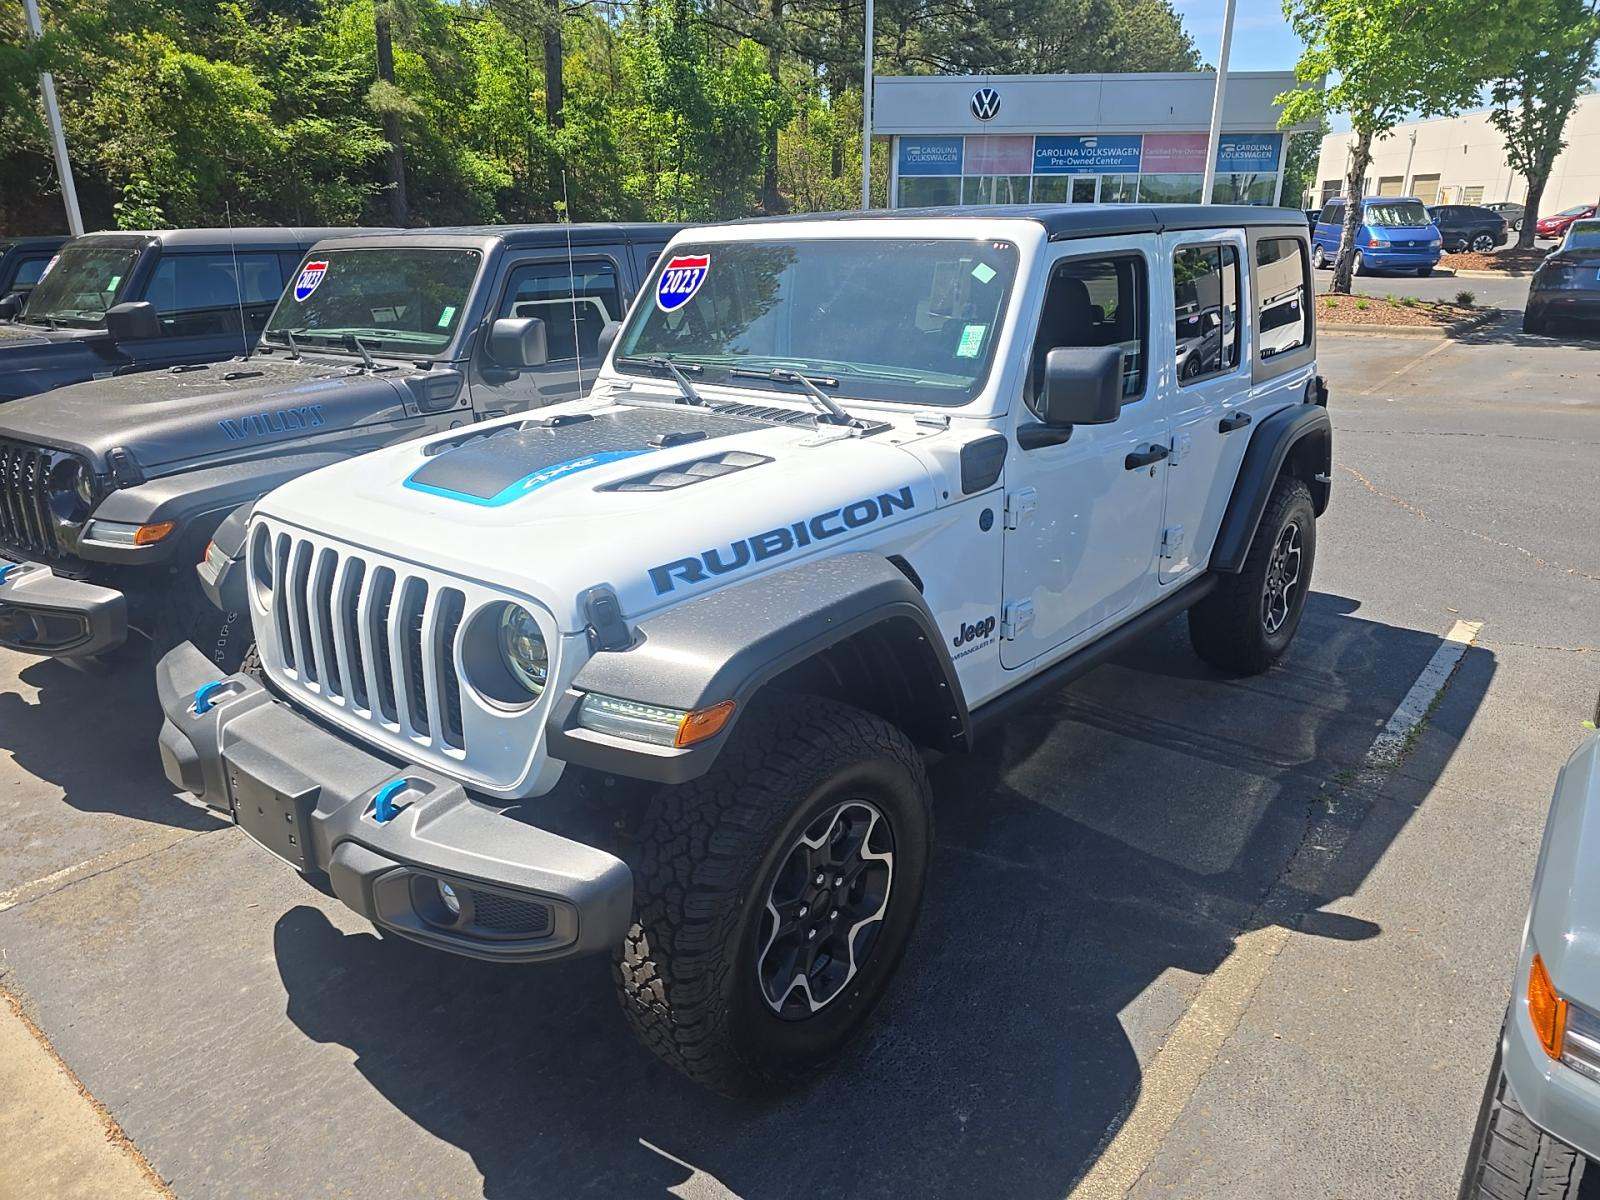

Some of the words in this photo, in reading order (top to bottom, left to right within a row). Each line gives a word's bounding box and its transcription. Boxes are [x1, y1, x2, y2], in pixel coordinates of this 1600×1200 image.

[972, 88, 1001, 119] VW
[921, 146, 958, 154] CAROLINA
[1036, 148, 1079, 157] CAROLINA
[1080, 147, 1140, 157] VOLKSWAGEN
[1236, 143, 1273, 151] CAROLINA
[906, 154, 958, 162] VOLKSWAGEN
[1051, 157, 1094, 166] Pre-Owned
[1095, 157, 1122, 165] Center
[1220, 150, 1273, 159] VOLKSWAGEN
[298, 270, 321, 289] 2023
[660, 268, 700, 294] 2023
[218, 404, 327, 441] WILLYS
[647, 485, 915, 596] RUBICON
[953, 615, 996, 647] Jeep
